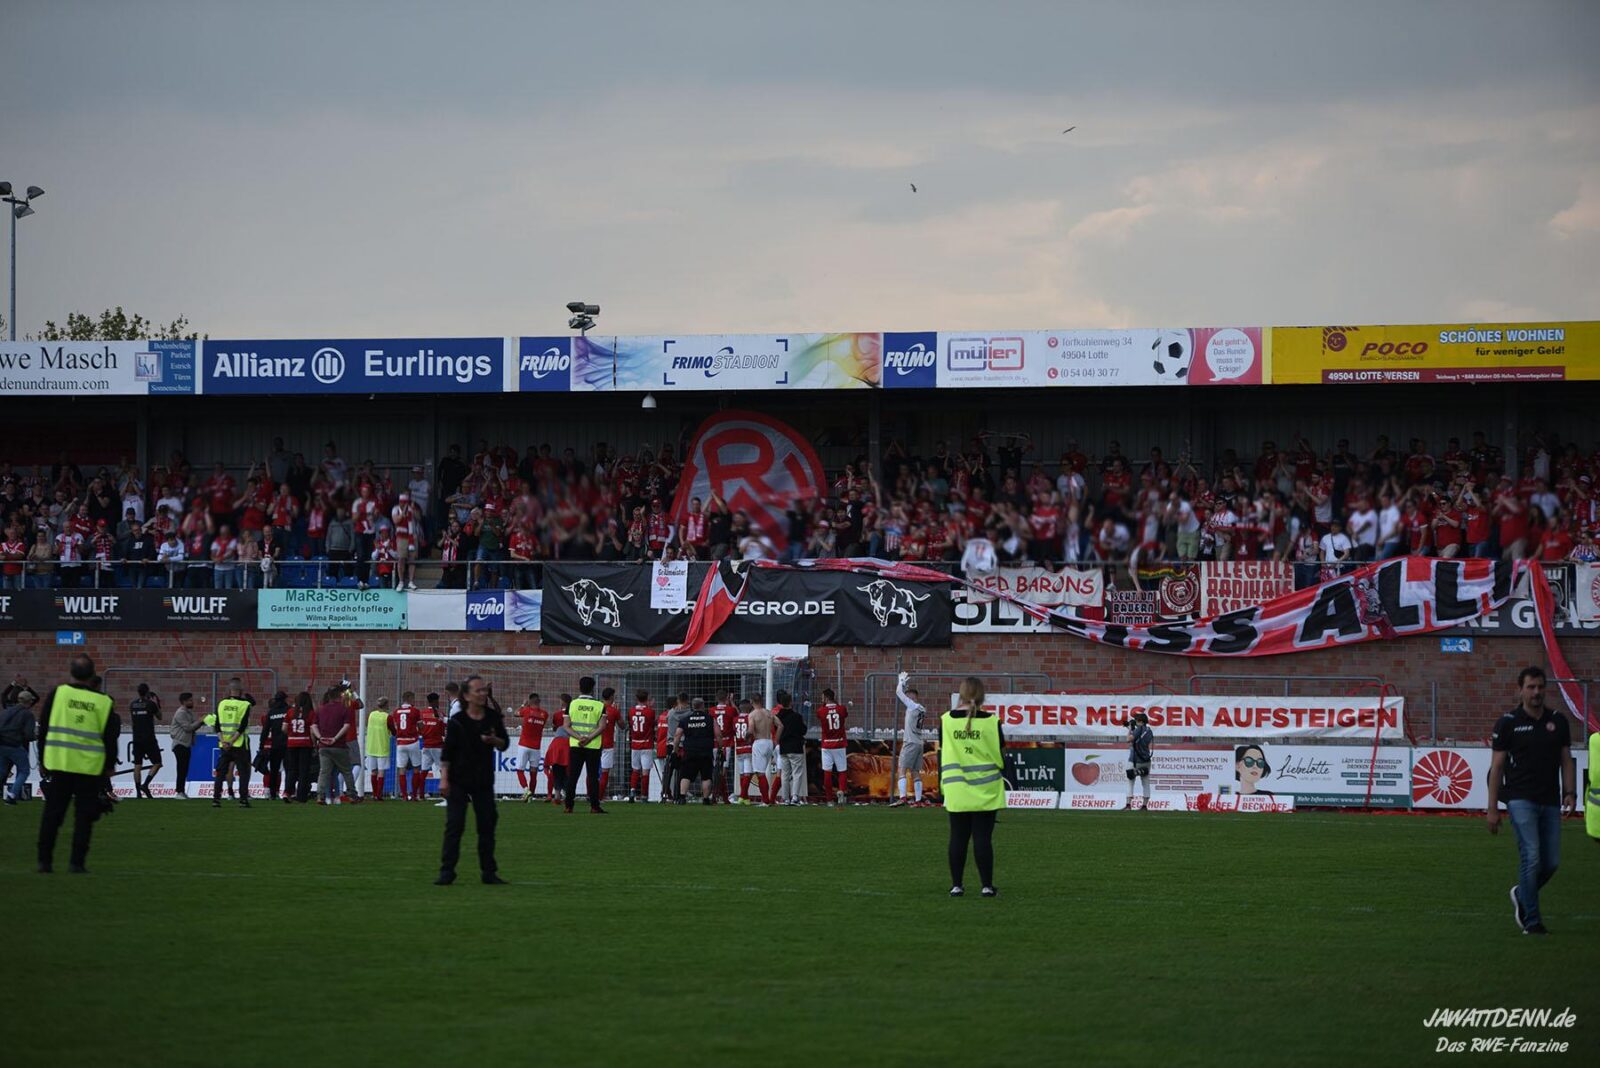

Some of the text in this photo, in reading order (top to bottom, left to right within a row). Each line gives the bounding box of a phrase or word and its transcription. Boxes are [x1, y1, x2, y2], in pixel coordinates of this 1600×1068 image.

[1122, 337, 1133, 346] 34
[1439, 327, 1565, 344] SCHÖNES WOHNEN
[954, 346, 1017, 360] müller
[1360, 342, 1428, 356] POCO
[1475, 345, 1565, 358] für weniger Geld!
[40, 346, 118, 370] Masch
[884, 349, 936, 368] FRIMO
[1061, 351, 1109, 360] 49504 Lotte
[213, 350, 492, 383] Allianz Eurlings
[520, 354, 570, 372] FRIMO
[1070, 368, 1080, 377] 54
[1097, 368, 1107, 377] 30
[1109, 368, 1120, 377] 77
[1327, 371, 1420, 381] 49504 LOTTE-WERSEN
[1207, 559, 1293, 579] ILLEGALE
[1016, 575, 1096, 595] BARONS
[1207, 579, 1293, 599] RADIKALE
[285, 589, 380, 602] MaRa-Service
[1113, 591, 1155, 601] SEKTON
[63, 596, 119, 613] WULFF
[171, 596, 227, 614] WULFF
[270, 605, 394, 615] Garten- und Friedhofspflege
[467, 603, 504, 615] FRIMO
[1113, 602, 1155, 613] BAUERN
[305, 614, 358, 623] Wilma Rapelius
[72, 632, 82, 644] P
[399, 714, 407, 730] 8
[826, 713, 840, 730] 13
[1213, 707, 1397, 729] AUFSTEIGEN
[953, 730, 981, 740] ORDNER
[1152, 756, 1219, 764] EBENSMITTELPUNKT
[1008, 798, 1052, 807] BECKHOFF
[1071, 799, 1116, 808] BECKHOFF
[1131, 800, 1170, 809] ECHOFF
[1187, 801, 1233, 811] BEHOFF
[1242, 802, 1288, 811] BECKHOFF
